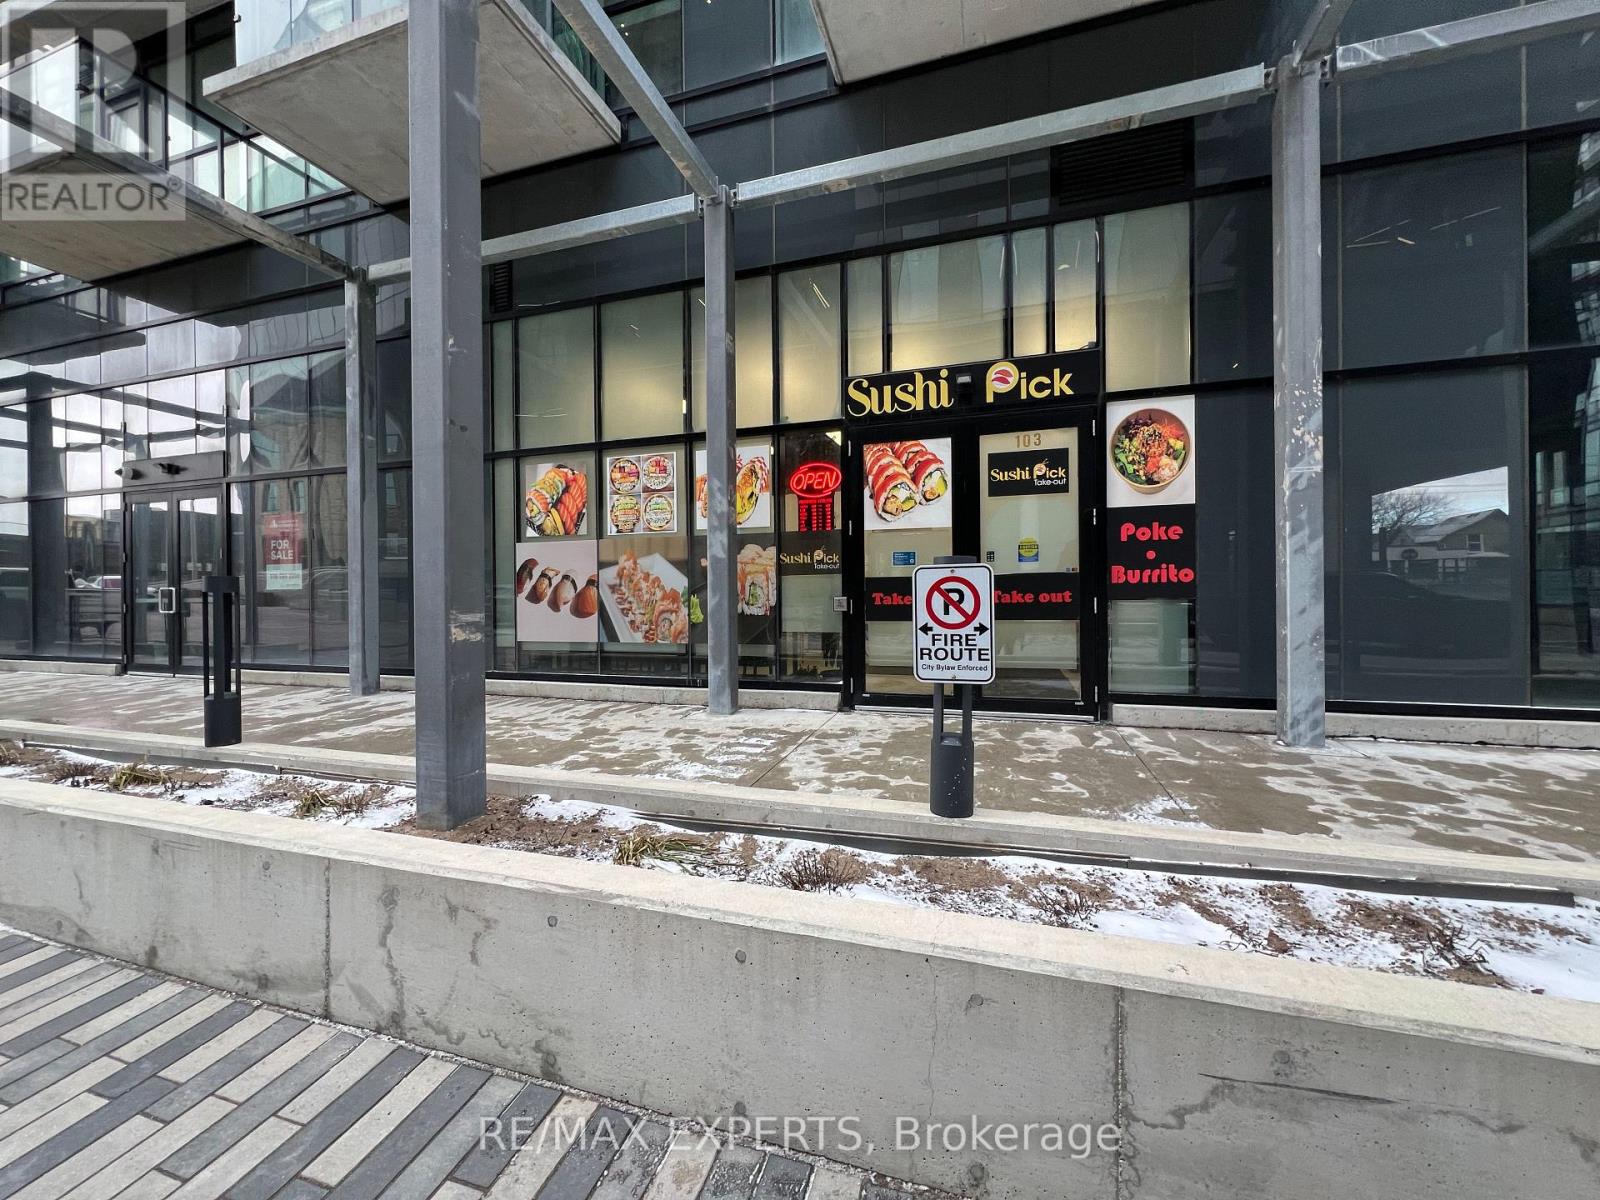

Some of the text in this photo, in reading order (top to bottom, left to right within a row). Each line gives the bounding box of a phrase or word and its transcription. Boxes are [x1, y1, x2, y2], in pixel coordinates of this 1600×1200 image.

[847, 361, 1074, 417] Sushi Pick
[1015, 433, 1042, 448] 103
[990, 463, 1066, 482] Sushi Pick
[793, 472, 836, 489] OPEN
[1034, 478, 1067, 486] Take-out
[1120, 522, 1183, 541] Poke
[271, 540, 290, 549] FOR
[271, 550, 294, 560] SALE
[780, 550, 840, 564] Sushi Pick
[1111, 563, 1194, 584] Burrito
[872, 592, 912, 605] Take
[1038, 590, 1073, 603] out
[931, 634, 978, 647] FIRE
[919, 648, 990, 661] ROUTE
